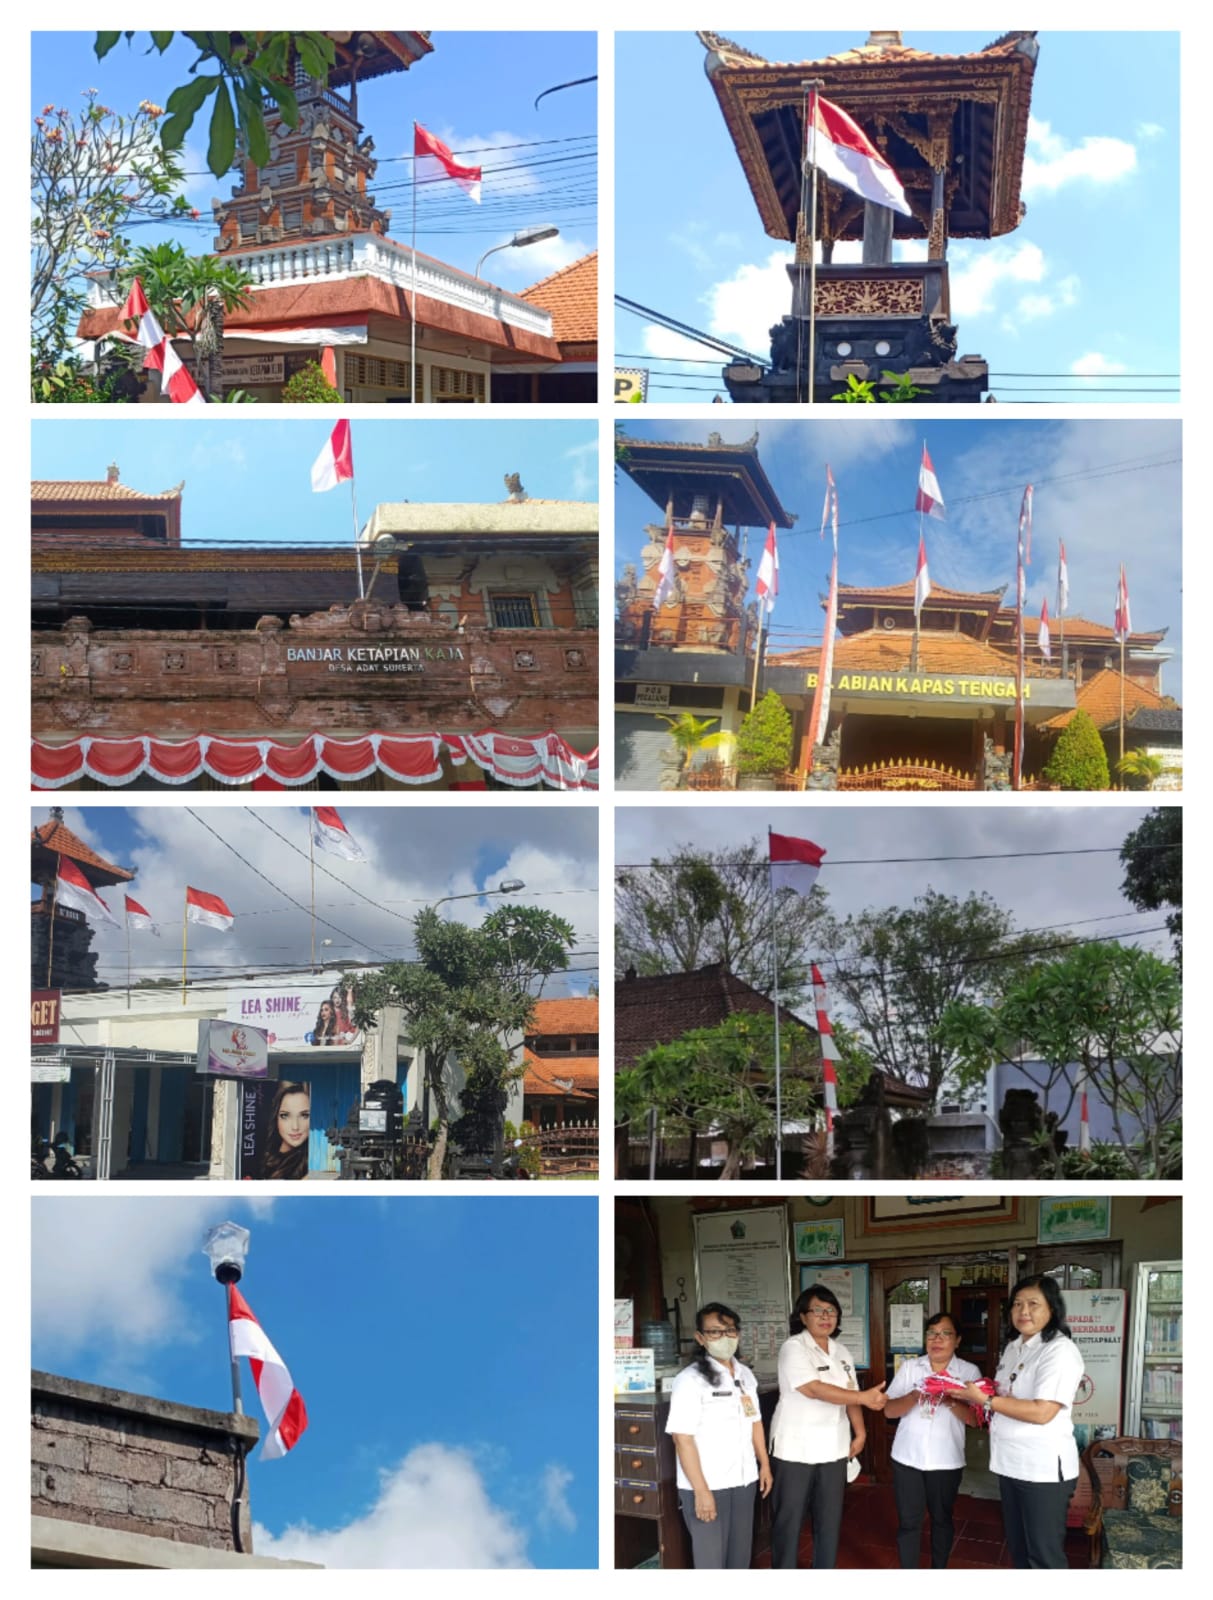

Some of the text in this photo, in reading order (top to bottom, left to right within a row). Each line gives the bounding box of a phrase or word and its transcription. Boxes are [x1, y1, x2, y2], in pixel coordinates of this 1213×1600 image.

[287, 647, 464, 661] BANJAR KETAPIAN KAJA
[328, 663, 425, 672] DESA ADAT SUMERTA
[838, 675, 893, 692] ABIAN
[895, 677, 955, 695] KAPAS
[32, 1000, 57, 1026] GET
[241, 996, 301, 1014] LEA SHINE
[244, 1091, 257, 1156] LEA SHINE
